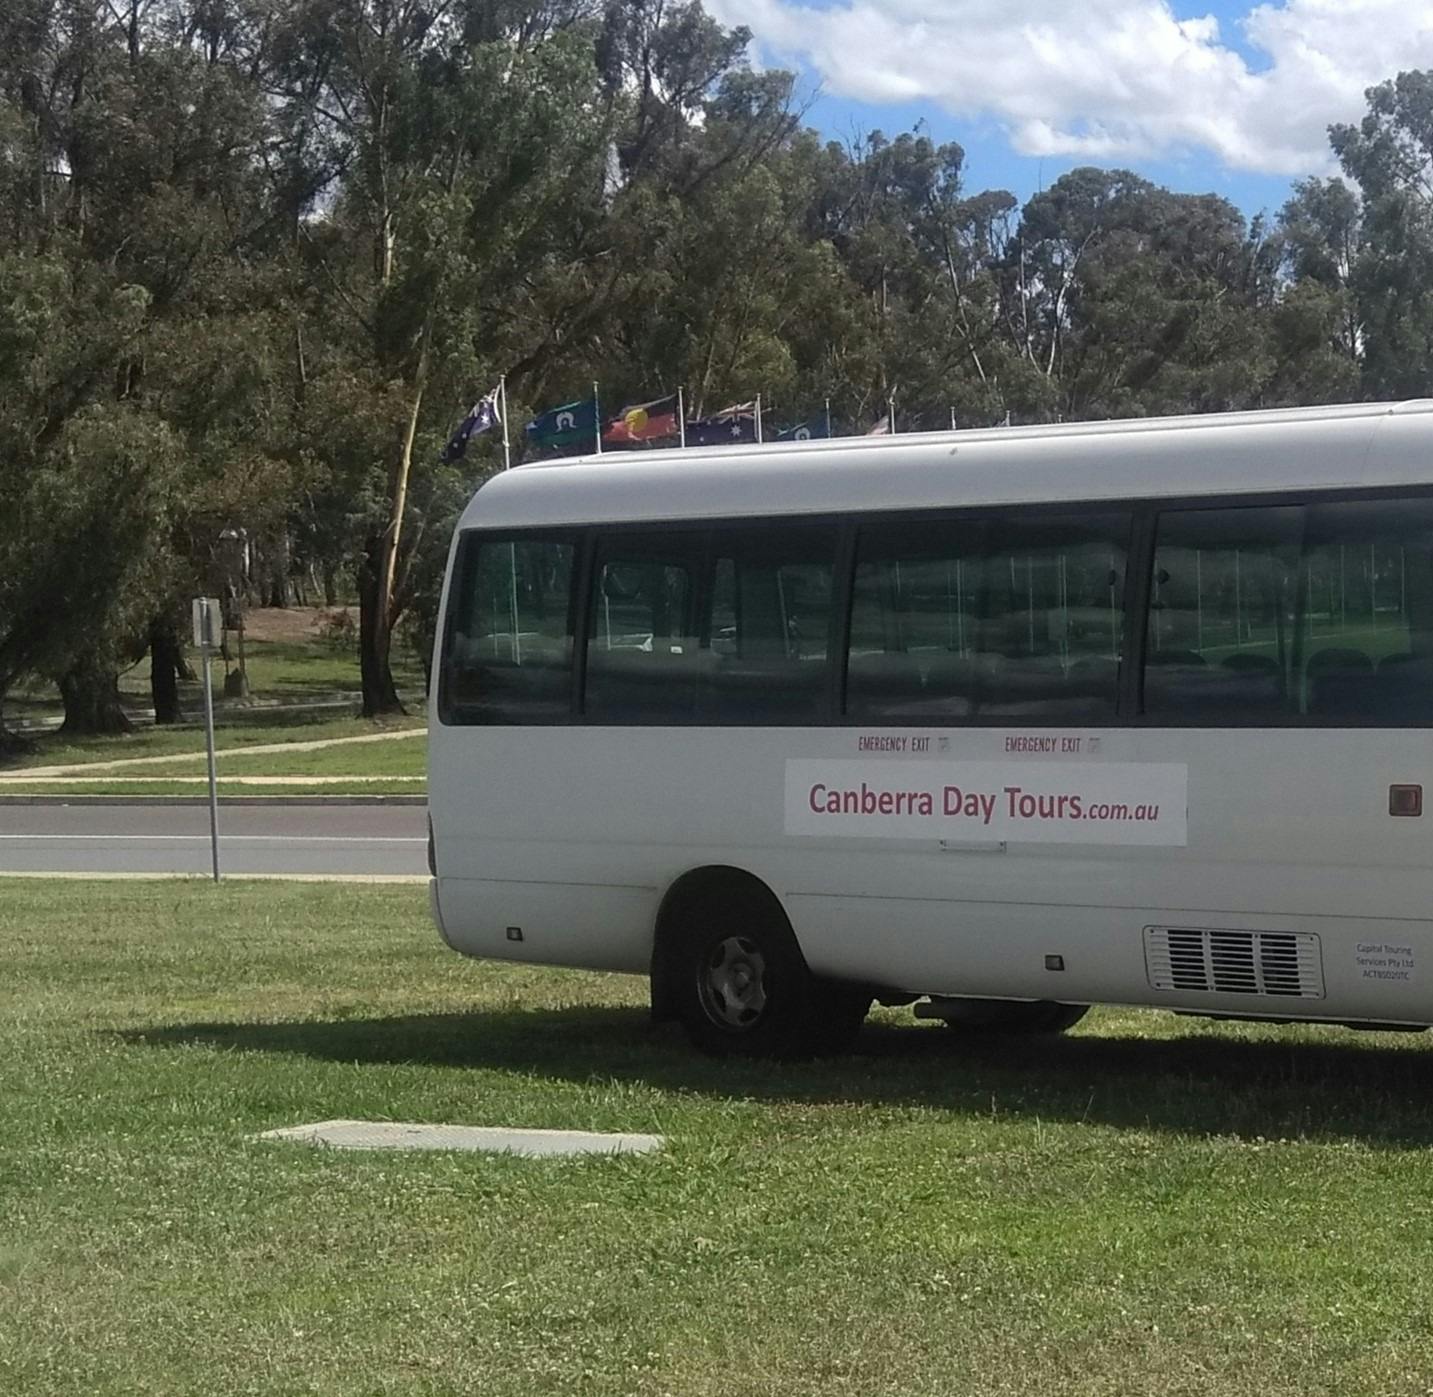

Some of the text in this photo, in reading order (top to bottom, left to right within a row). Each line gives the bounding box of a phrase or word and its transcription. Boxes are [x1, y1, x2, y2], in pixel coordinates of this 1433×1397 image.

[858, 736, 930, 751] EMERGENCY EXIT
[1005, 736, 1081, 752] EMERGENCY EXIT
[809, 782, 1159, 824] Canberra Day Tours.com.au
[1384, 944, 1412, 956] Touring
[1356, 956, 1415, 968] Services Pty Ltd
